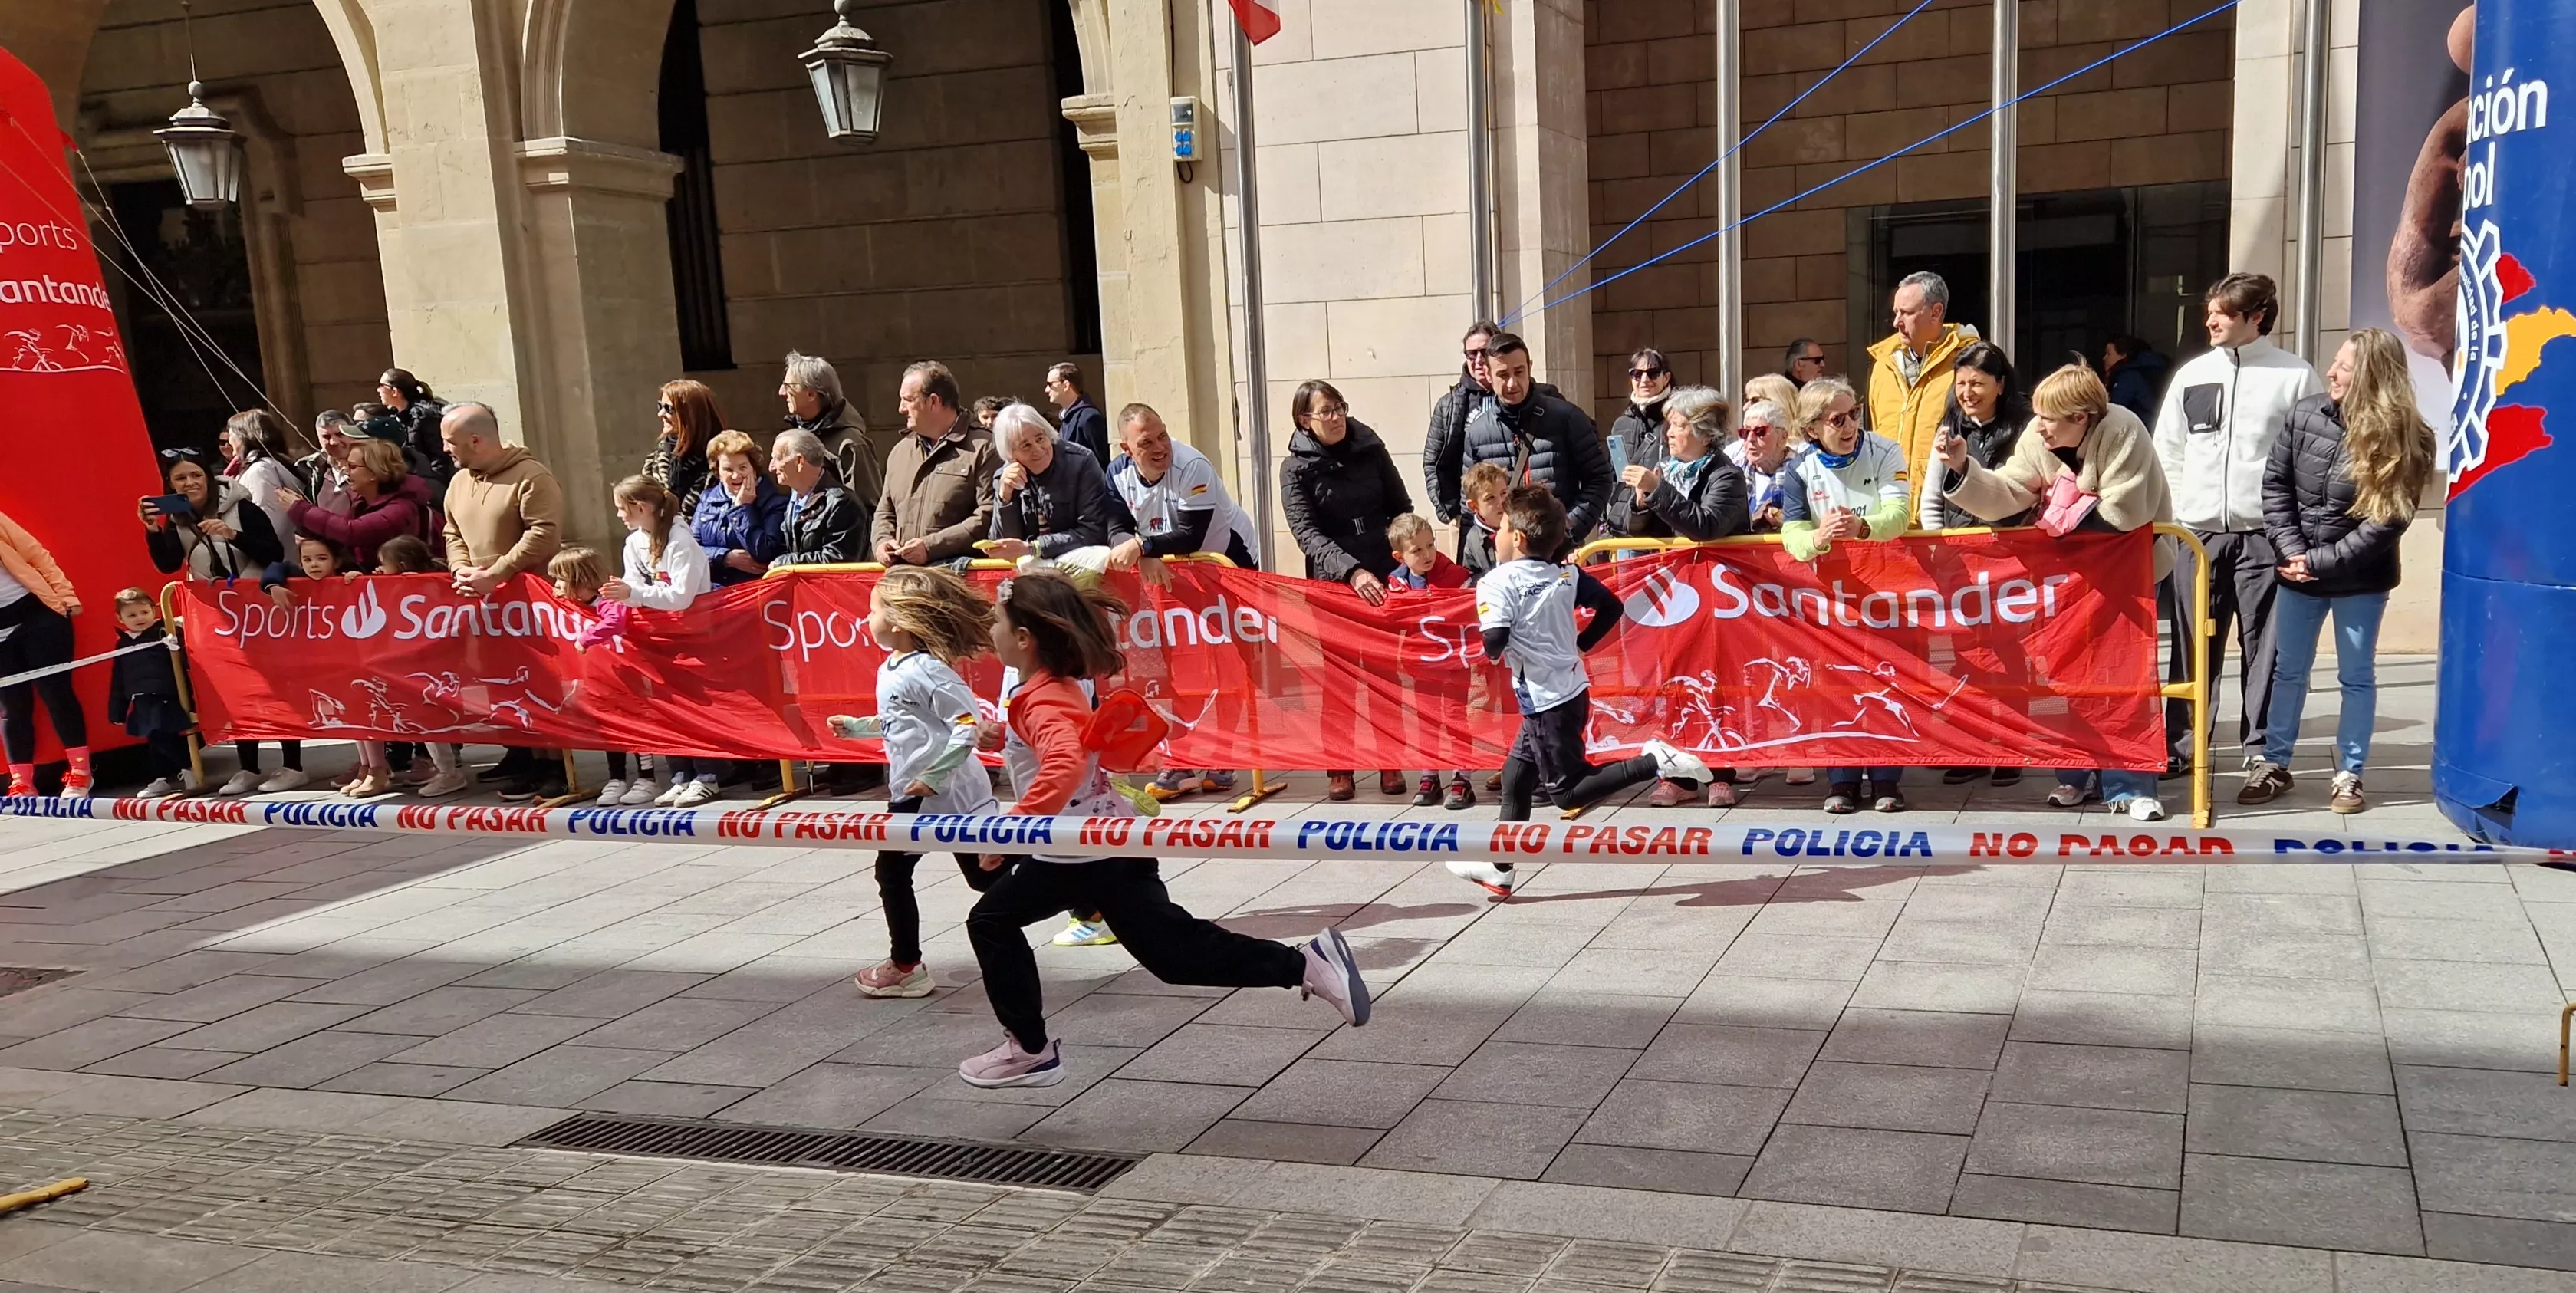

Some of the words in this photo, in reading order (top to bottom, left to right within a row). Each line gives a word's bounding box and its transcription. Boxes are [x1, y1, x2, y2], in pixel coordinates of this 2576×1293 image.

[2464, 141, 2495, 212] pol
[0, 219, 77, 254] ports
[0, 274, 113, 313] antande
[215, 591, 335, 648] Sports
[1712, 564, 2068, 627] Santander
[112, 797, 148, 821] NO
[156, 798, 248, 824] PASAR
[264, 802, 379, 827] POLICIA
[396, 805, 436, 830] NO
[446, 807, 551, 833] PASAR
[568, 809, 696, 836] POLICIA
[717, 811, 770, 839] NO
[774, 812, 893, 841] PASAR
[910, 814, 1054, 844] POLICIA
[1079, 817, 1135, 847] NO
[1143, 818, 1276, 848] PASAR
[1298, 821, 1459, 851] POLICIA
[1489, 824, 1551, 854] NO
[1562, 825, 1714, 856] PASAR
[1742, 828, 1933, 857] POLICIA
[1969, 832, 2038, 857] NO
